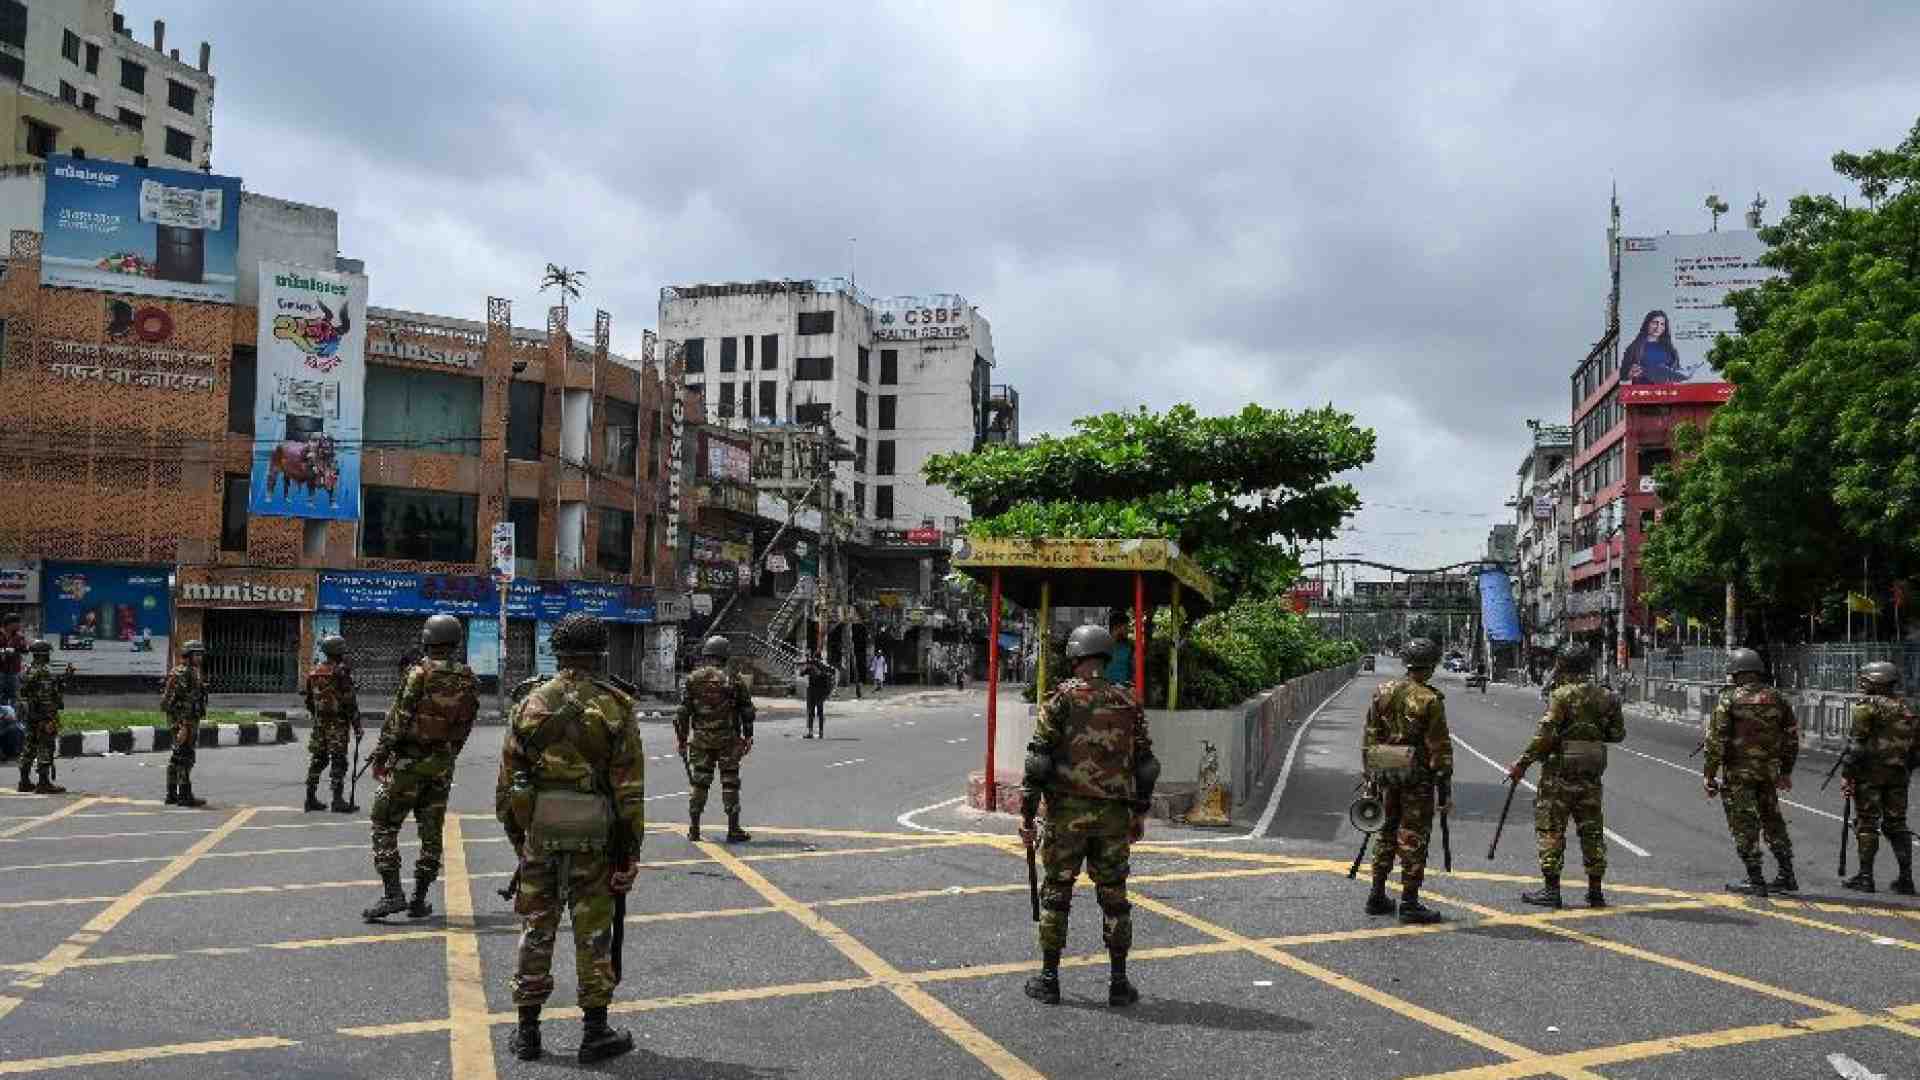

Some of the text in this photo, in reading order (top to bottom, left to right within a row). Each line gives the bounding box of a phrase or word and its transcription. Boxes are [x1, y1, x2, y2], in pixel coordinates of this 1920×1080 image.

[275, 273, 348, 296] minister
[872, 326, 969, 340] HEALTH CENTER
[181, 582, 306, 602] minister
